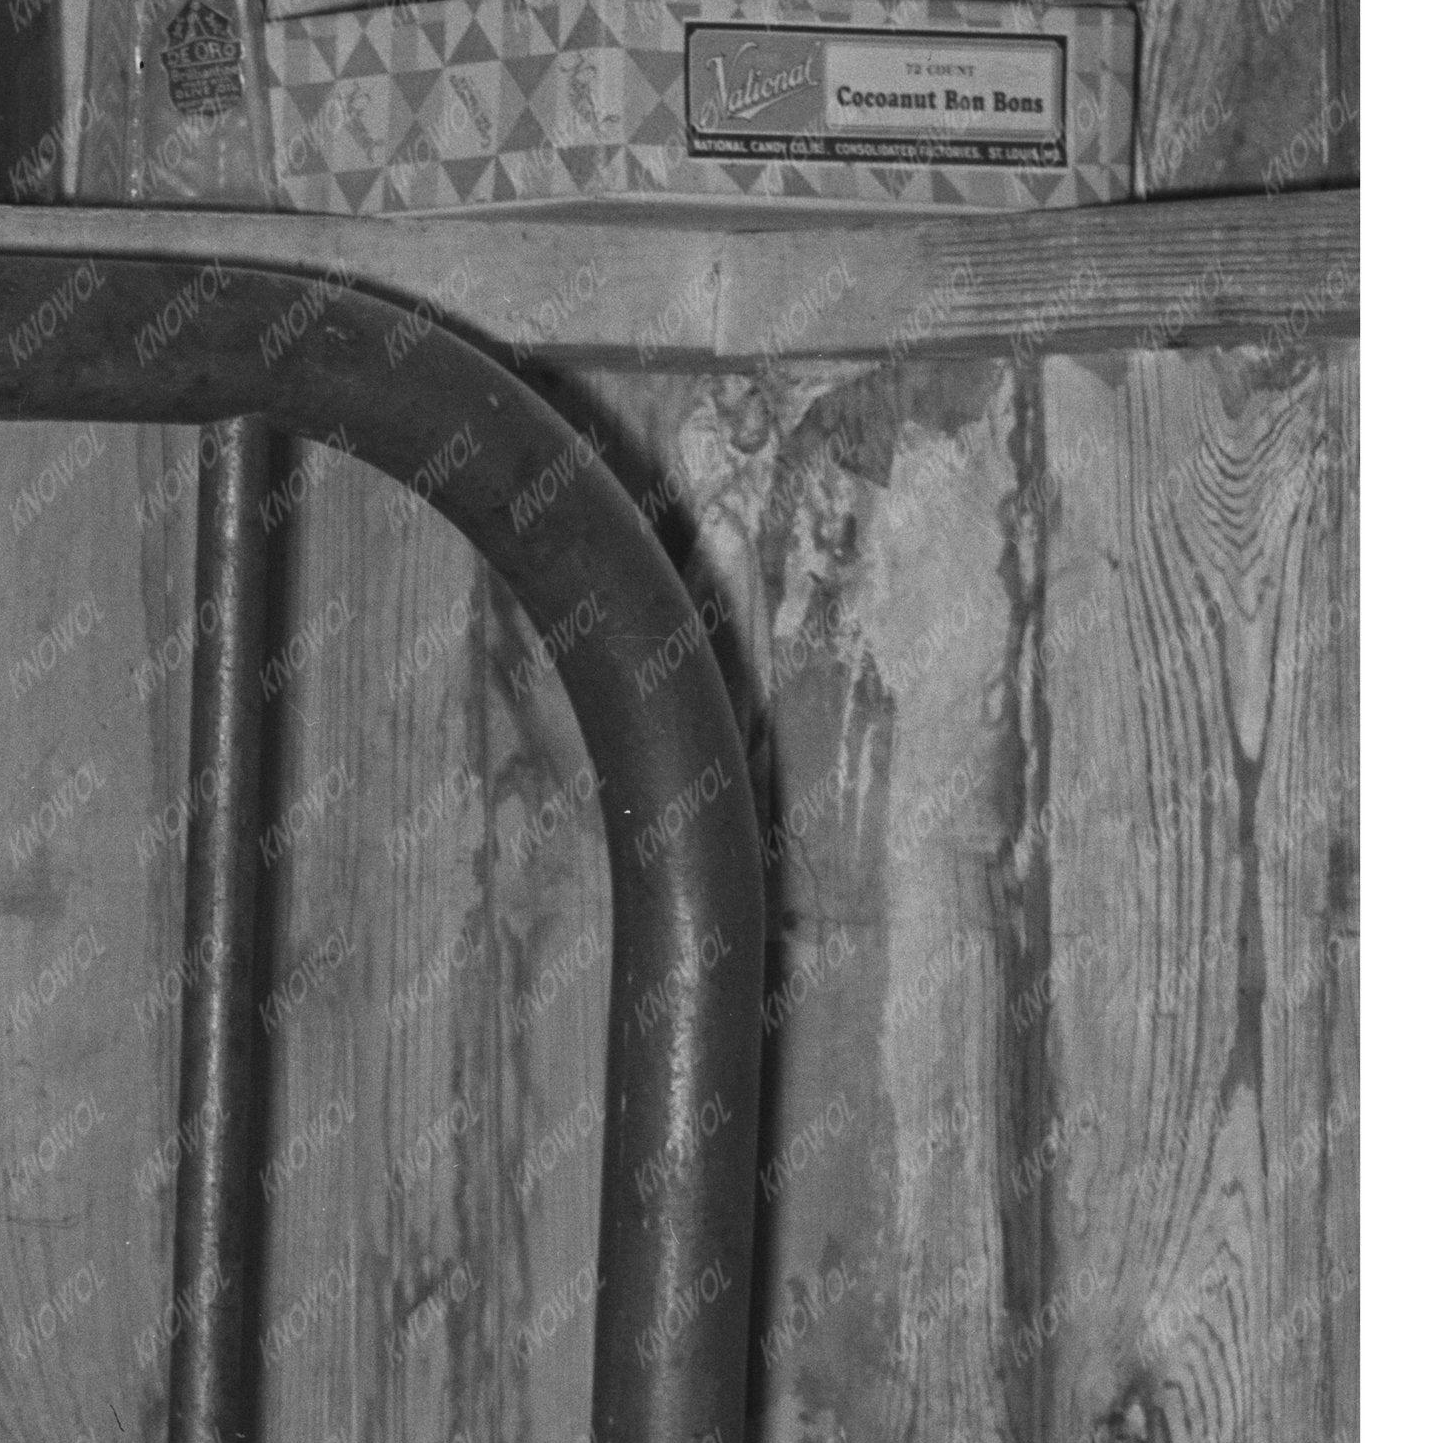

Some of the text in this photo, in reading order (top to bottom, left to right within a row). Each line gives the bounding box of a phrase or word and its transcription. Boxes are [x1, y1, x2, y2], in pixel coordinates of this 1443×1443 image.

[195, 42, 236, 61] ORO
[906, 63, 975, 77] 72 COUNT
[699, 41, 820, 126] National
[837, 85, 1044, 114] Cocoanut Bon Bons
[693, 140, 749, 154] NATIONAL
[750, 141, 787, 154] CANDY
[835, 143, 917, 157] CONSOLIDATED
